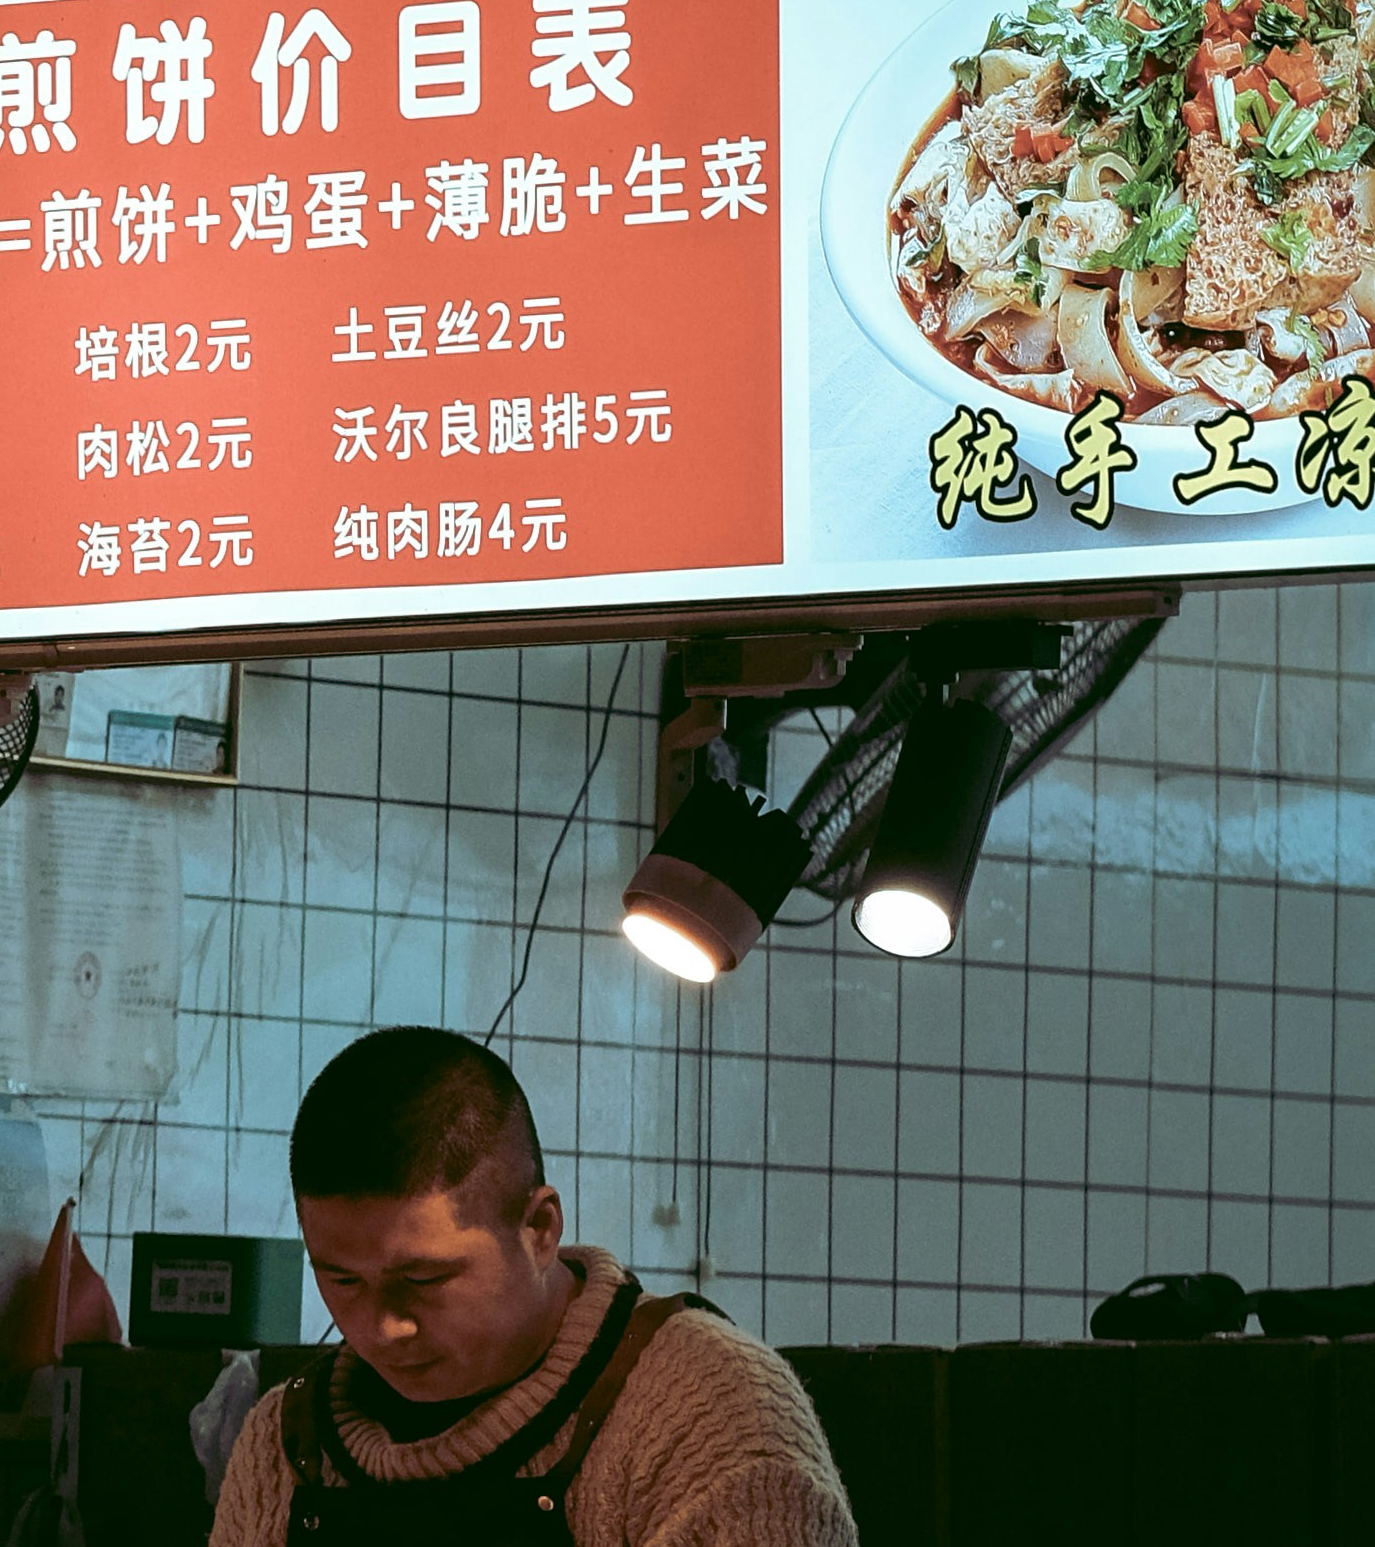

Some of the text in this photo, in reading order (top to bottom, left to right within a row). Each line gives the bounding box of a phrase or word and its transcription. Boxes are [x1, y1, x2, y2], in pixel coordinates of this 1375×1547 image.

[74, 319, 253, 382] 培根2元
[331, 296, 567, 365] 土豆丝2元
[75, 416, 253, 482] 肉松2元
[331, 388, 673, 467] 沃尔良腿排5元
[76, 512, 255, 580] 海苔2元
[332, 497, 568, 562] 纯肉肠4元
